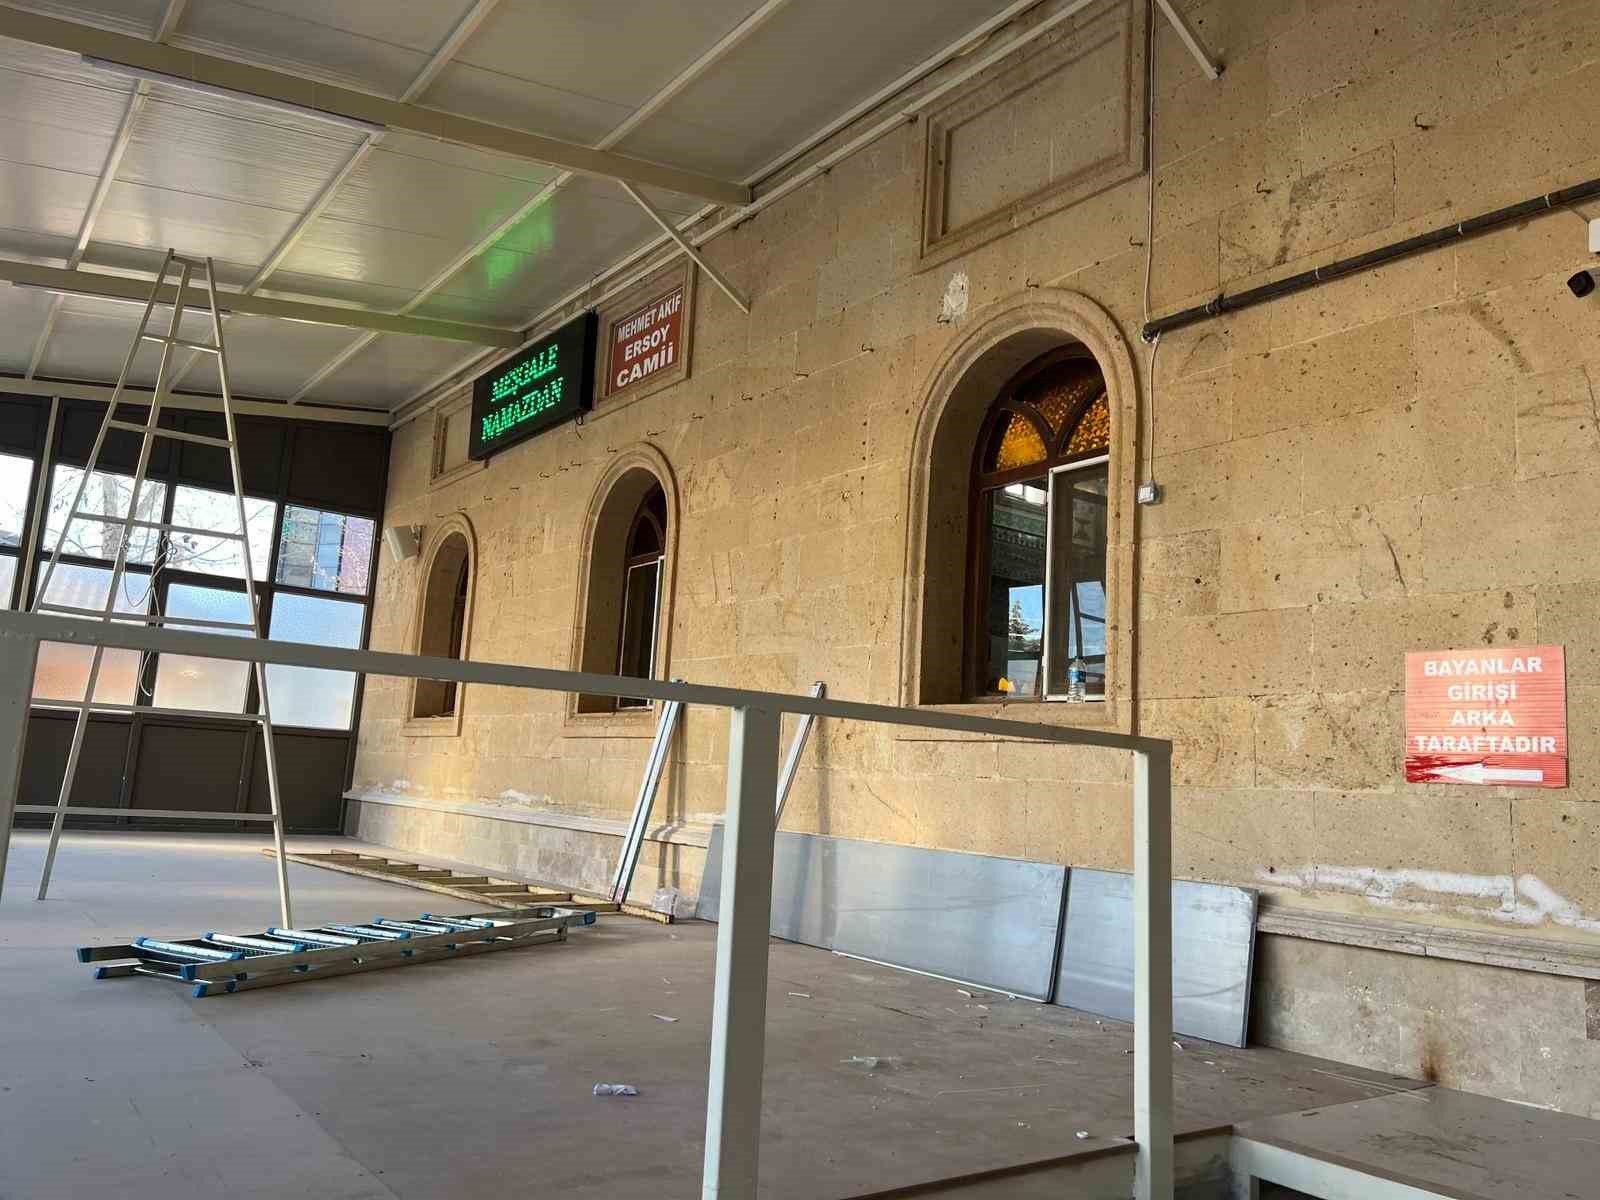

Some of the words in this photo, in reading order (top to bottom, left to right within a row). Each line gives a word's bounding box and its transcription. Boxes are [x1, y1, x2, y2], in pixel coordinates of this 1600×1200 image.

[617, 308, 657, 343] MEHMET
[657, 294, 682, 321] AKİF
[624, 324, 670, 362] ERSOY
[481, 377, 564, 440] NAMAZDAN
[1423, 656, 1543, 677] BAYANLAR
[1447, 681, 1518, 704] GİRİŞİ
[1450, 709, 1515, 727] ARKA
[1414, 735, 1557, 753] TARAFTADIR
